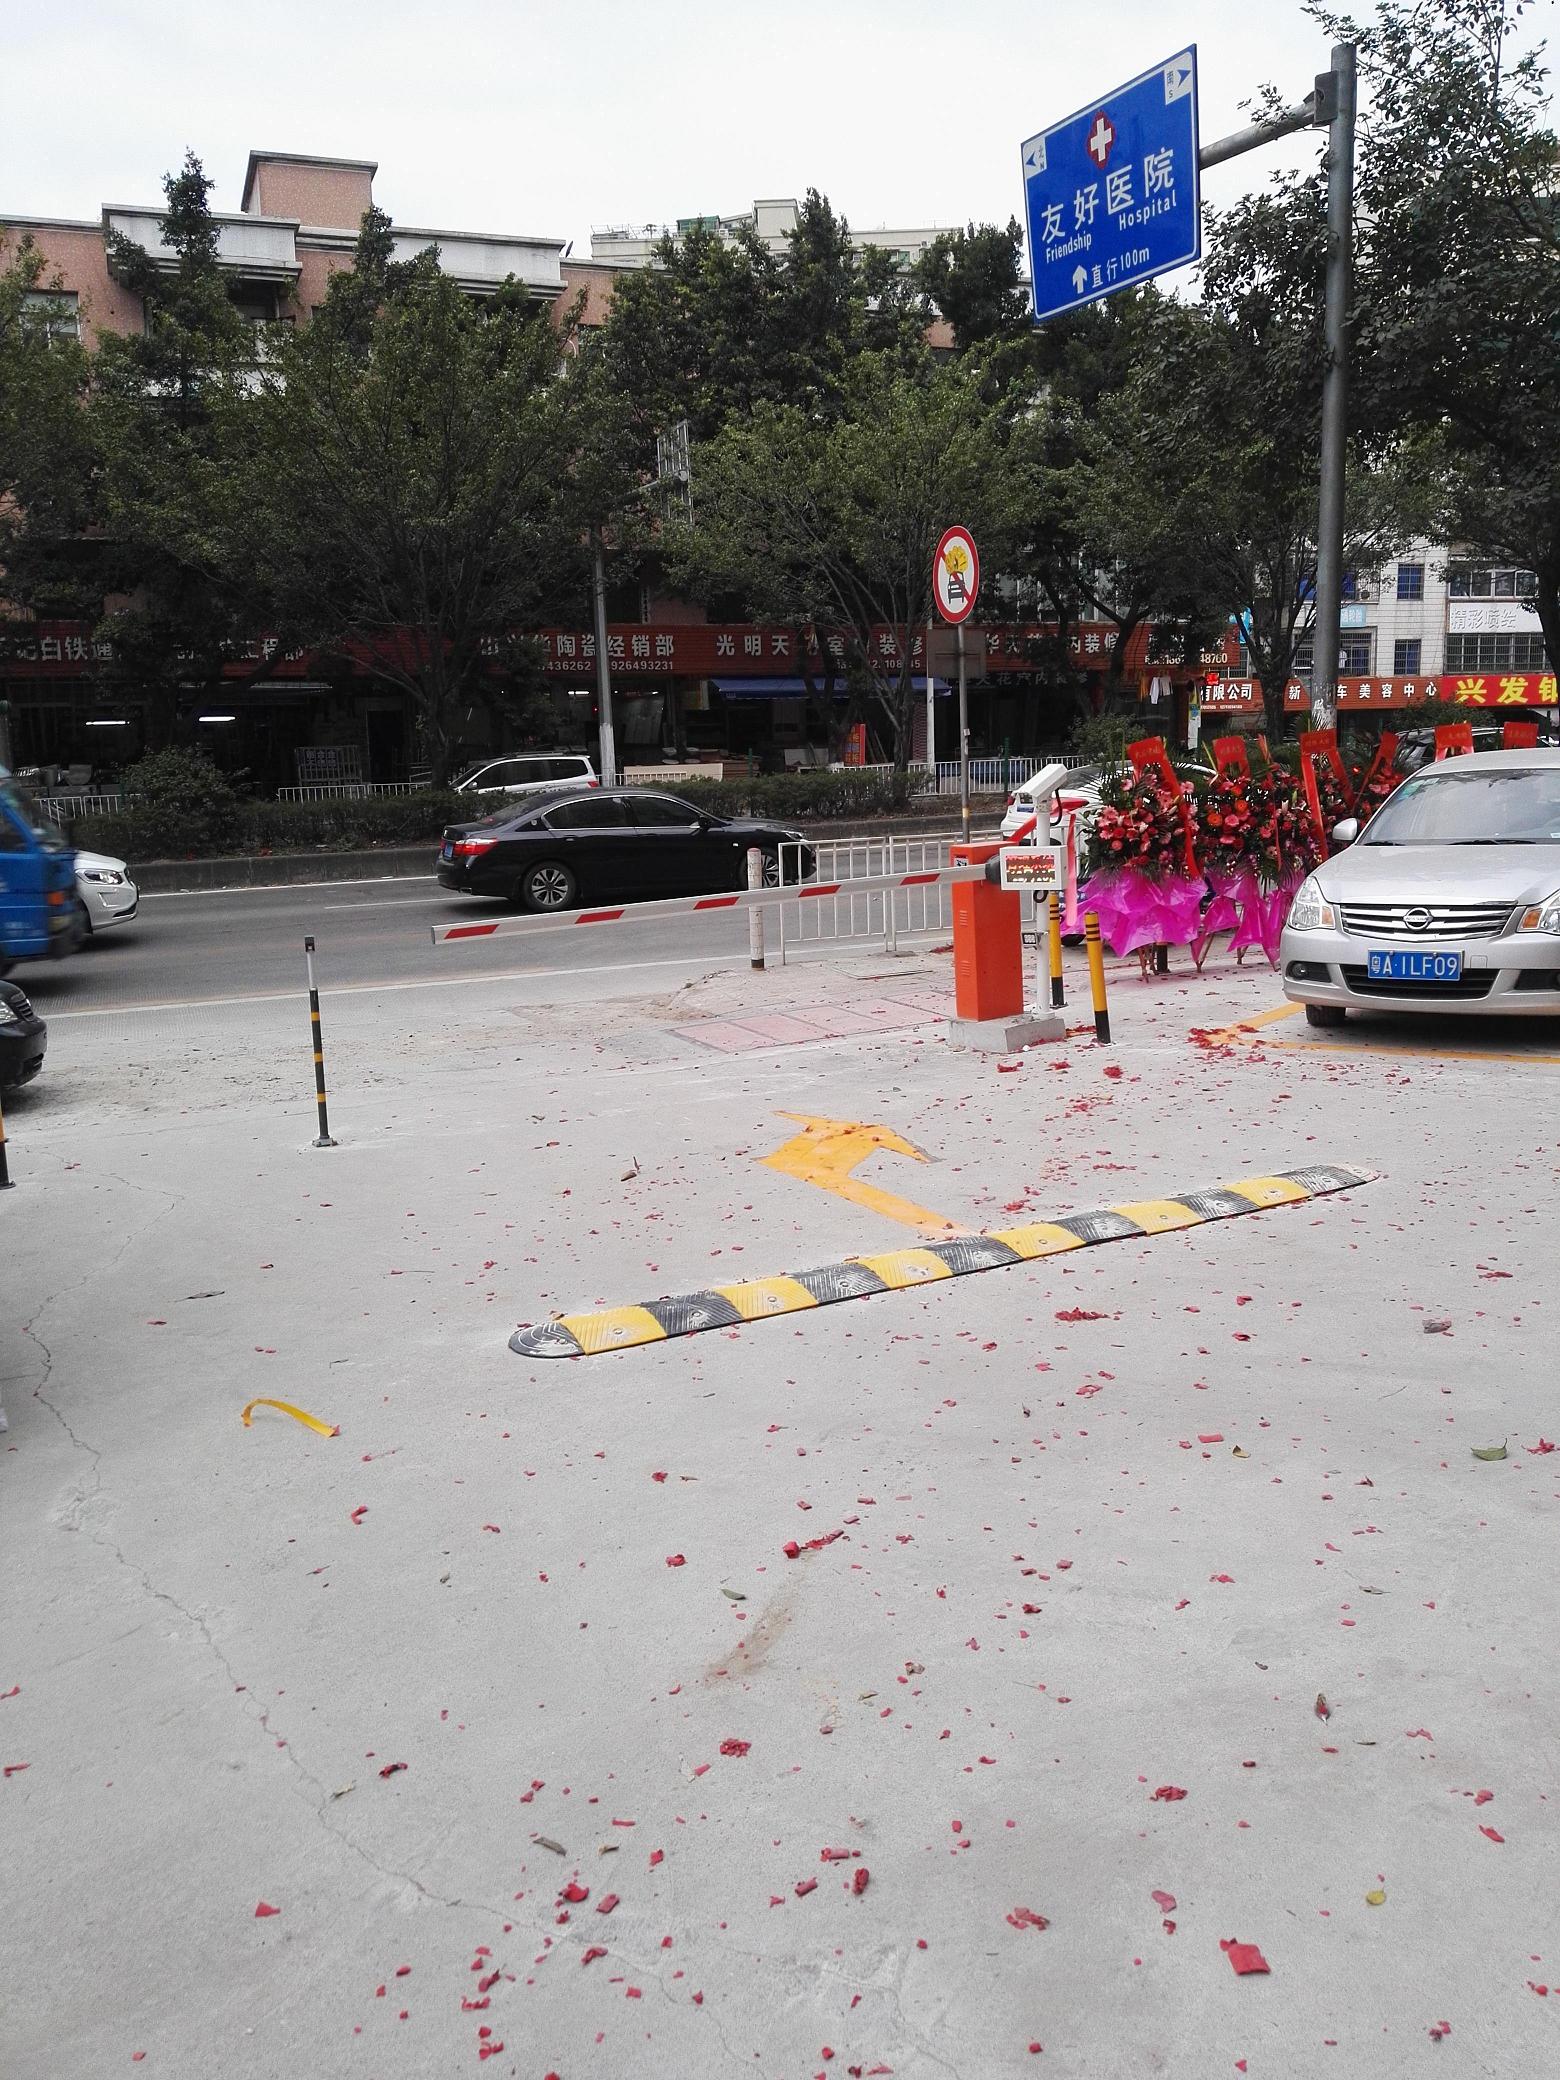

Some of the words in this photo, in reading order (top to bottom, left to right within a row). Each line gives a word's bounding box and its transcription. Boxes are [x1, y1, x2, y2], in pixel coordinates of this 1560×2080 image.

[1041, 147, 1174, 244] 友好医院
[1046, 230, 1092, 264] Friendship
[1119, 189, 1177, 231] Hospital
[538, 661, 592, 671] 436262
[611, 661, 673, 671] 926493231
[1288, 681, 1438, 699] 新车美容中心
